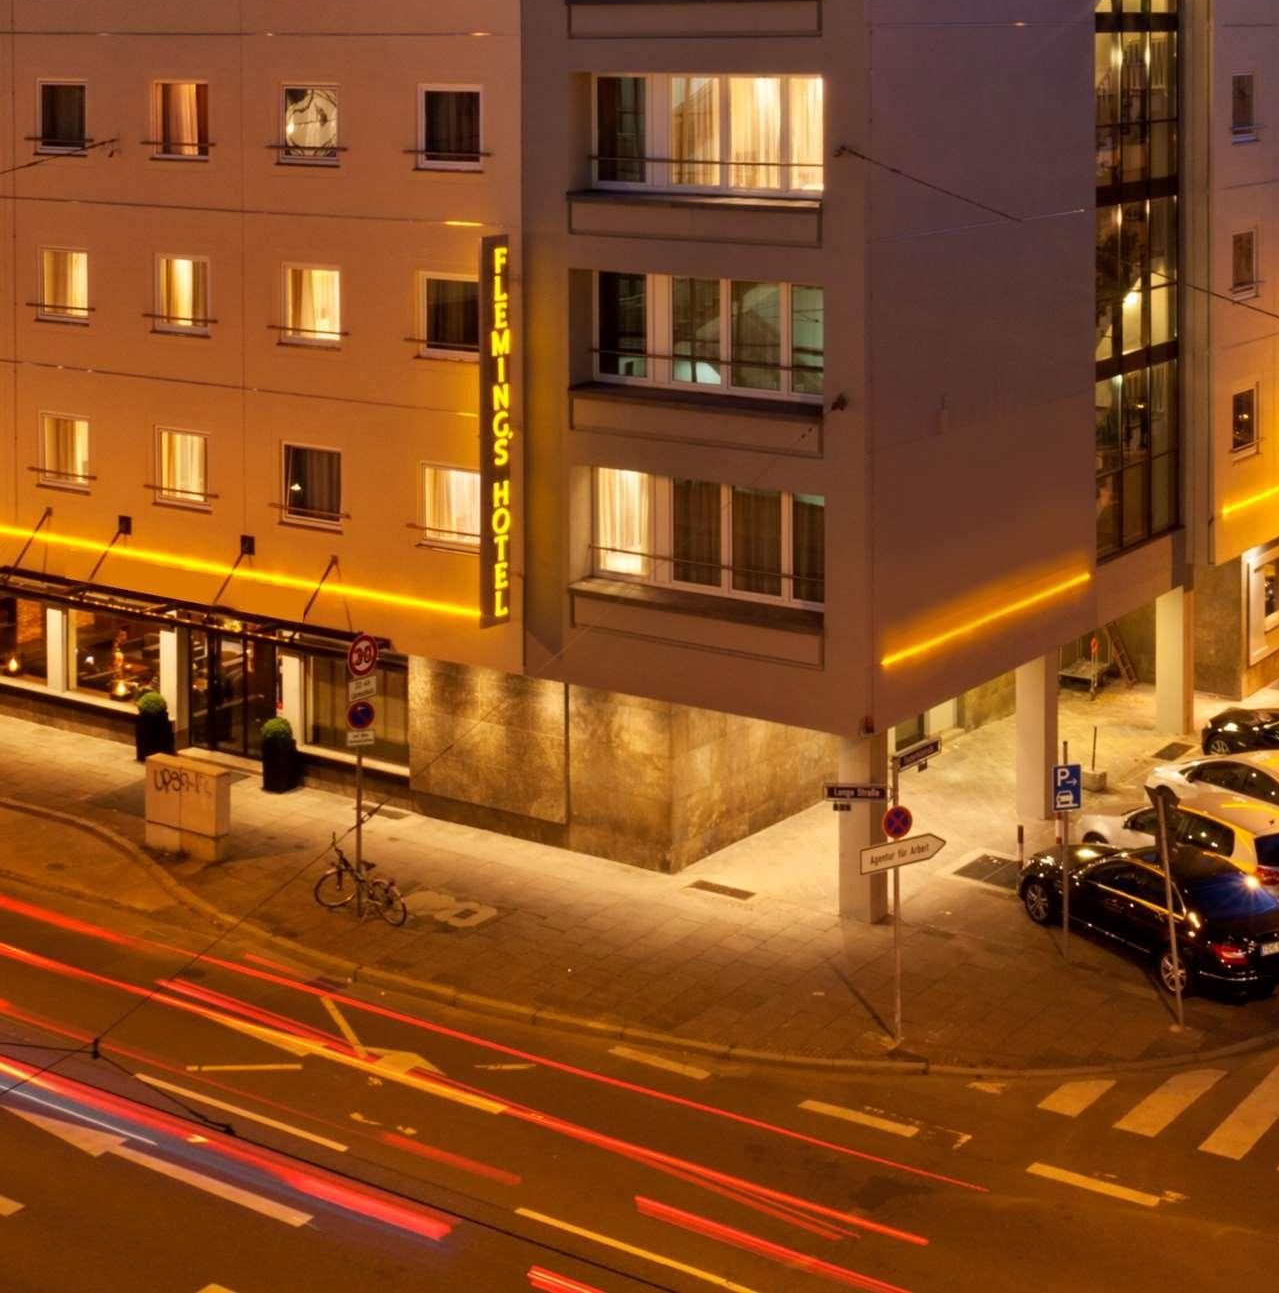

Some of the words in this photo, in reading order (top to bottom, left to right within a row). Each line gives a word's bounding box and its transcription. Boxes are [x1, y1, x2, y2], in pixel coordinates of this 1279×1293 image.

[491, 247, 514, 466] FLEMING'S
[492, 480, 511, 617] HOTEL
[354, 646, 372, 667] 30
[1057, 768, 1070, 787] P
[834, 788, 855, 800] Lange
[871, 851, 895, 866] Agentur
[897, 849, 908, 859] für
[910, 843, 930, 855] Arbeit
